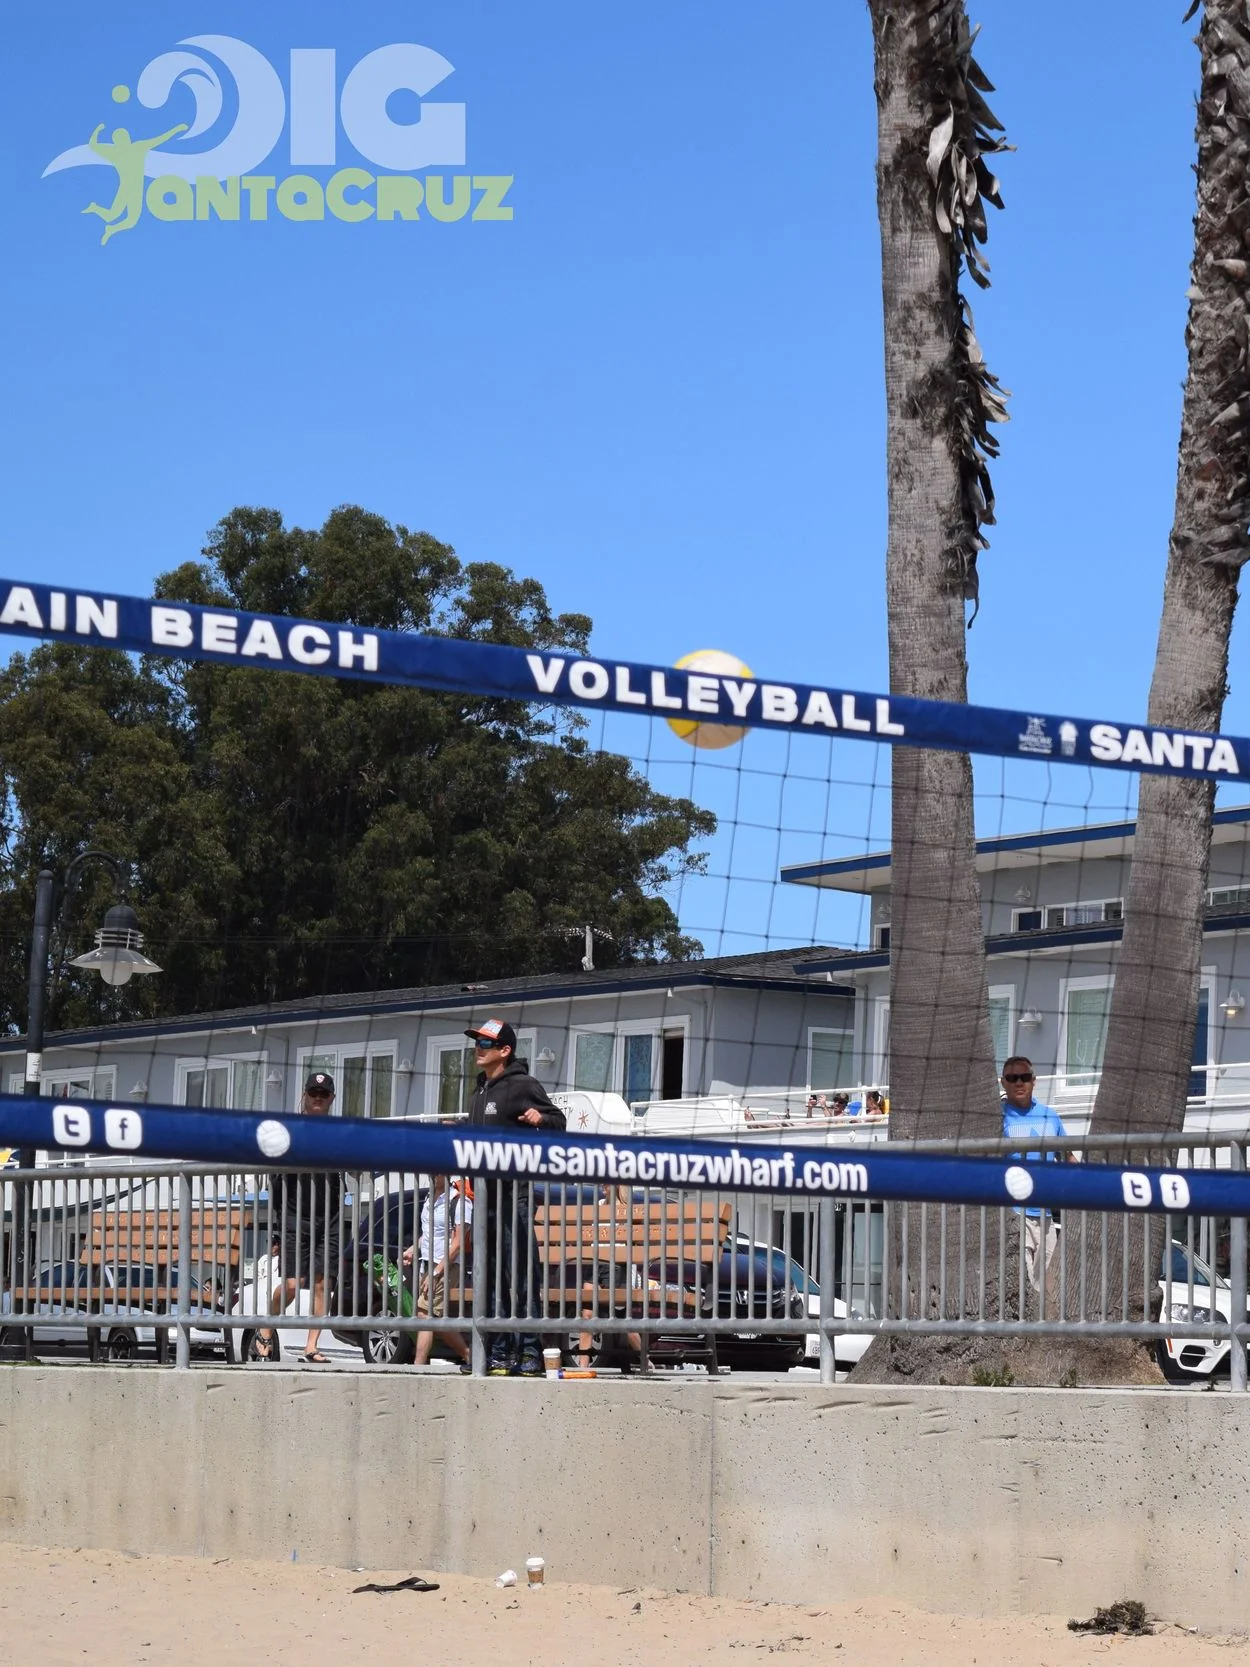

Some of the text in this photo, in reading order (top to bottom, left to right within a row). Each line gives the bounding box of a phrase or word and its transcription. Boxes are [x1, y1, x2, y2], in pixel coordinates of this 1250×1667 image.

[151, 606, 379, 671] BEACH
[526, 654, 905, 736] VOLLEYBALL
[1089, 724, 1239, 774] SANTA
[452, 1139, 869, 1192] www.santacruzwharf.com
